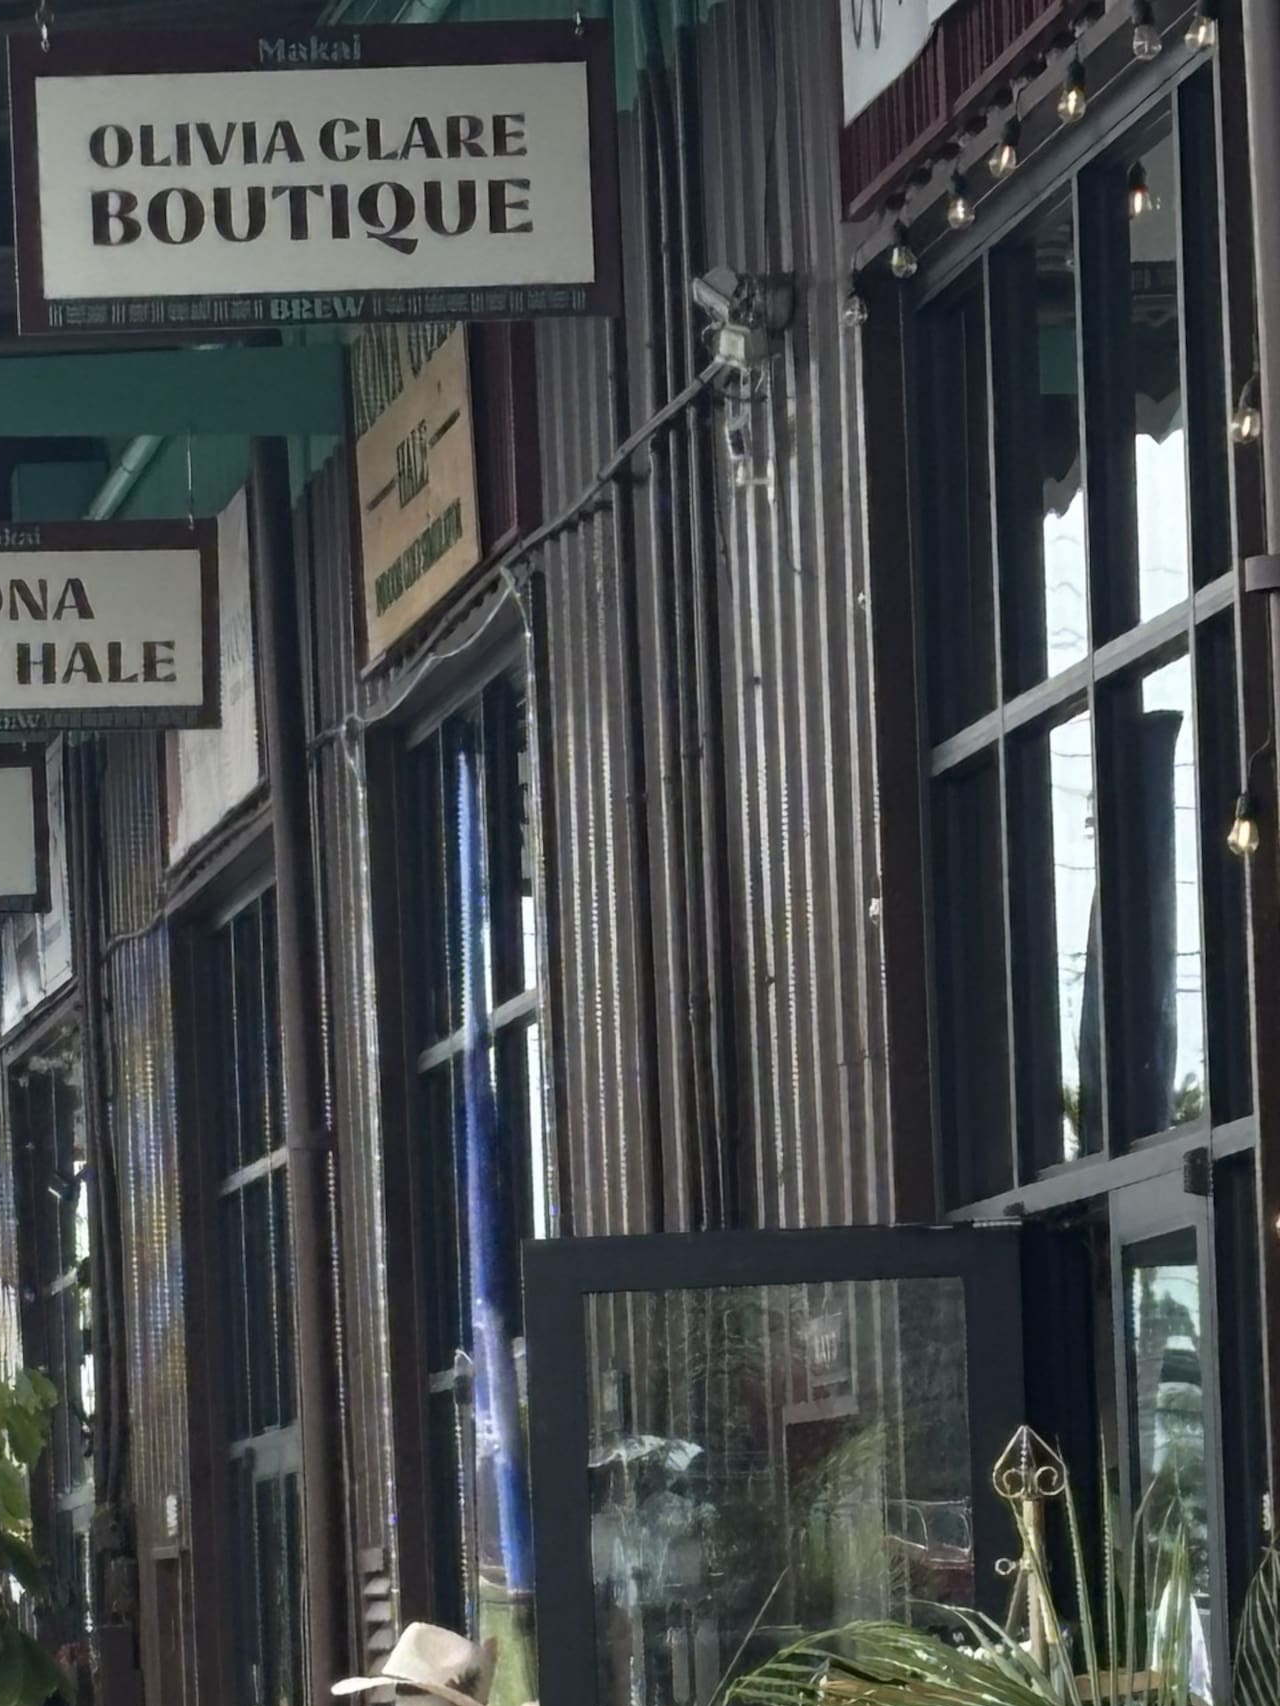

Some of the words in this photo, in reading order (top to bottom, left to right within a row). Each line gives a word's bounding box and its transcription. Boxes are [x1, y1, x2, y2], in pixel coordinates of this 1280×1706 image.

[258, 33, 361, 64] Makai
[88, 119, 305, 169] OLIVIA
[319, 112, 528, 162] CLARE
[91, 178, 534, 255] BOUTIQUE
[270, 296, 364, 321] BREW
[16, 640, 177, 685] HALE
